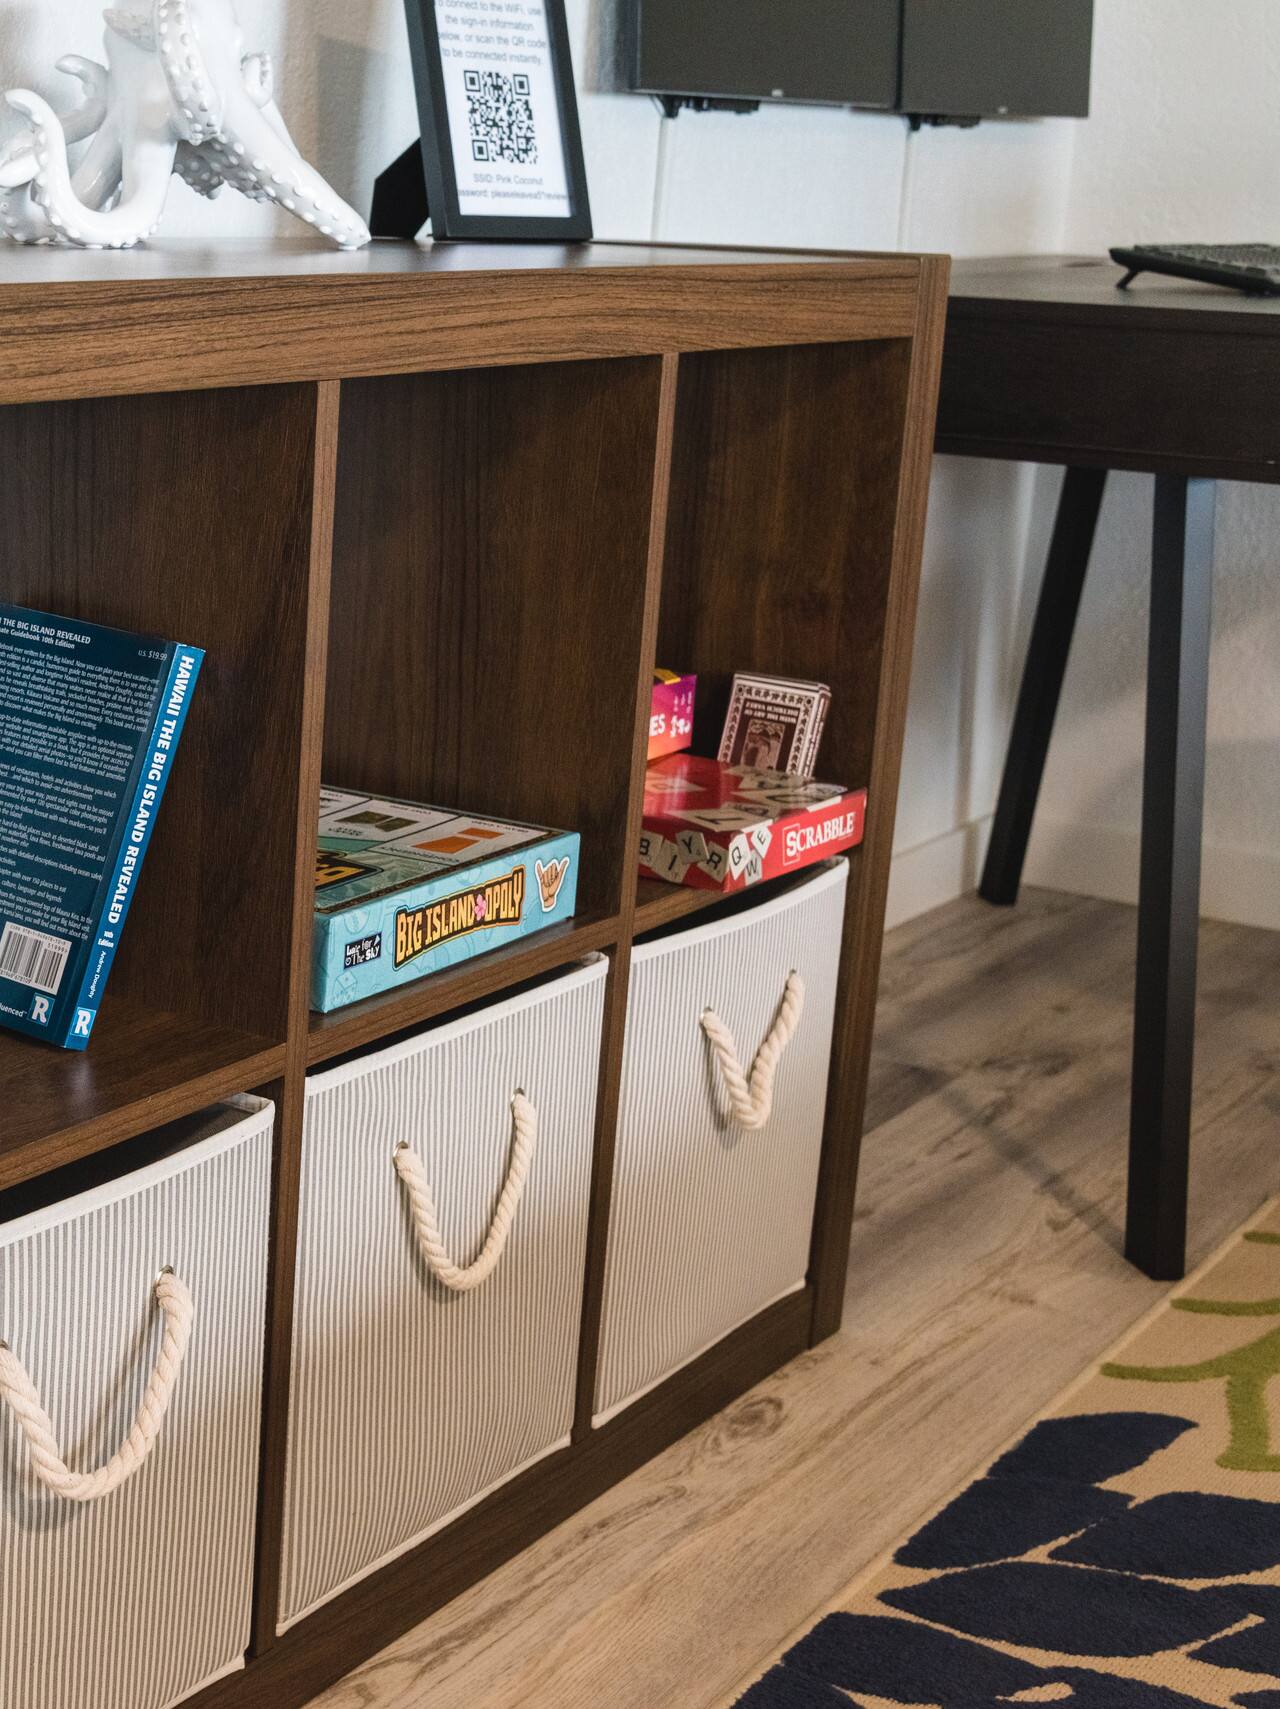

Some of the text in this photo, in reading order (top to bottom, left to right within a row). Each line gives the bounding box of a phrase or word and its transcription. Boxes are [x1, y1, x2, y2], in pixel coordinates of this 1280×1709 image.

[445, 15, 458, 25] the
[465, 50, 508, 61] connected
[2, 617, 16, 627] THE
[16, 620, 29, 630] BIG
[29, 623, 56, 636] ISLAND
[55, 629, 91, 643] REVEALED
[9, 628, 41, 641] Guidebook
[41, 635, 54, 644] 10th
[54, 638, 75, 648] Edition
[148, 650, 168, 661] $19.99
[107, 655, 195, 924] HAWAII THE BIG ISLAND REVEALED
[786, 812, 855, 857] SCRABBLE
[396, 872, 523, 964] BIG ISLAND OPOLY
[96, 950, 107, 974] Andrew
[32, 996, 49, 1023] R
[74, 1009, 91, 1036] R
